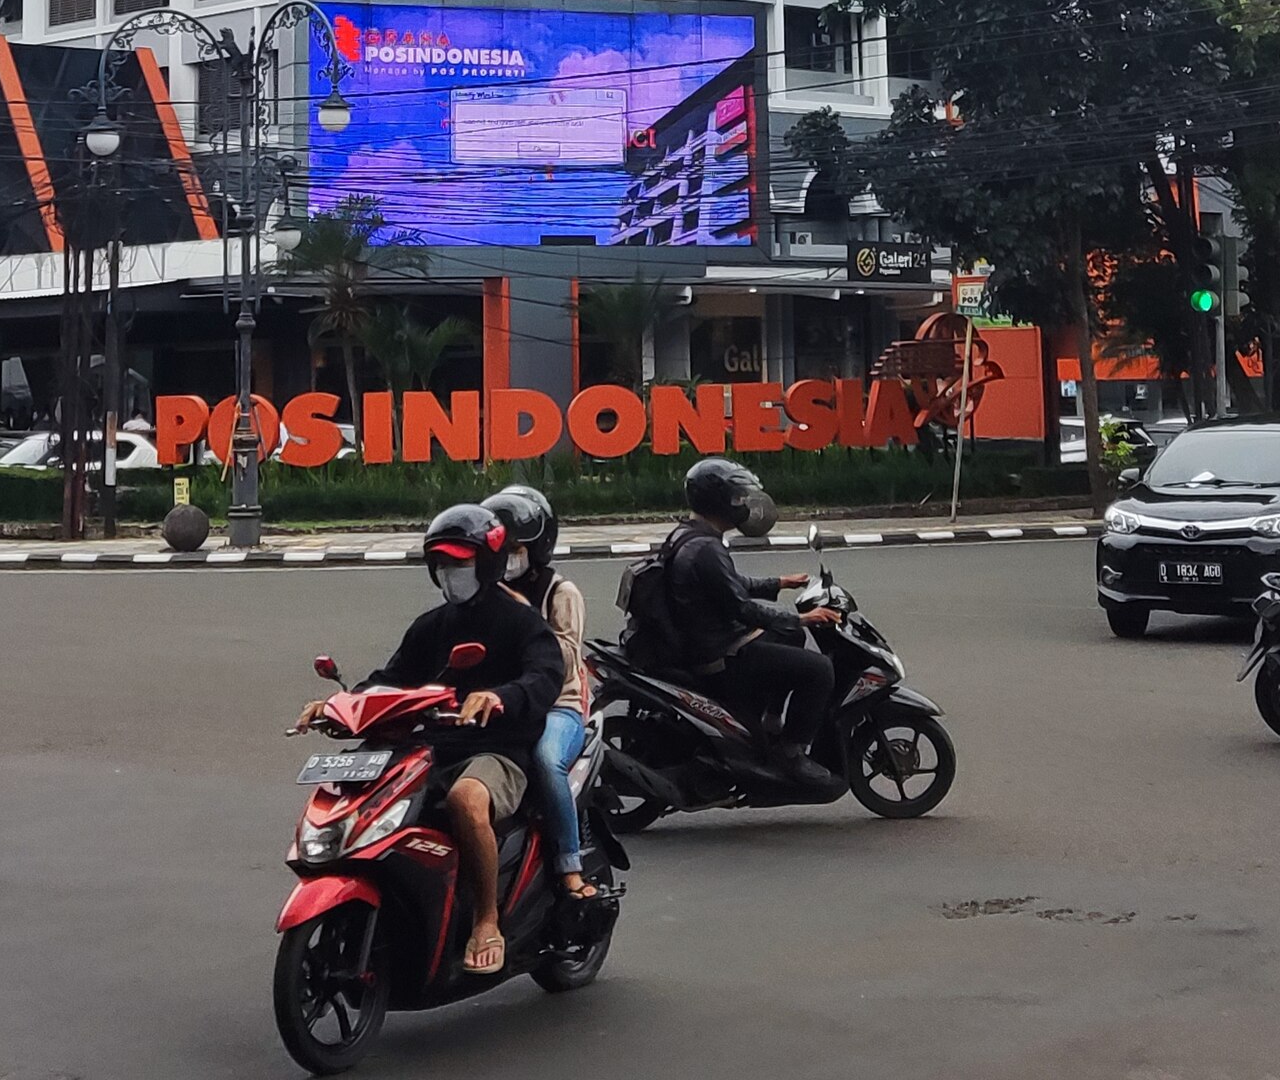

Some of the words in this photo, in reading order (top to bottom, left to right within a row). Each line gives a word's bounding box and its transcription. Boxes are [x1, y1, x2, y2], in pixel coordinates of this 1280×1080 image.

[365, 46, 524, 66] POSINDONESIA
[431, 67, 455, 76] POS
[880, 251, 912, 268] Galeri
[913, 252, 927, 269] 24
[724, 344, 760, 372] Gal
[156, 393, 343, 467] POS
[363, 377, 920, 464] INDONESIA
[308, 756, 320, 769] D
[405, 837, 453, 857] 125
